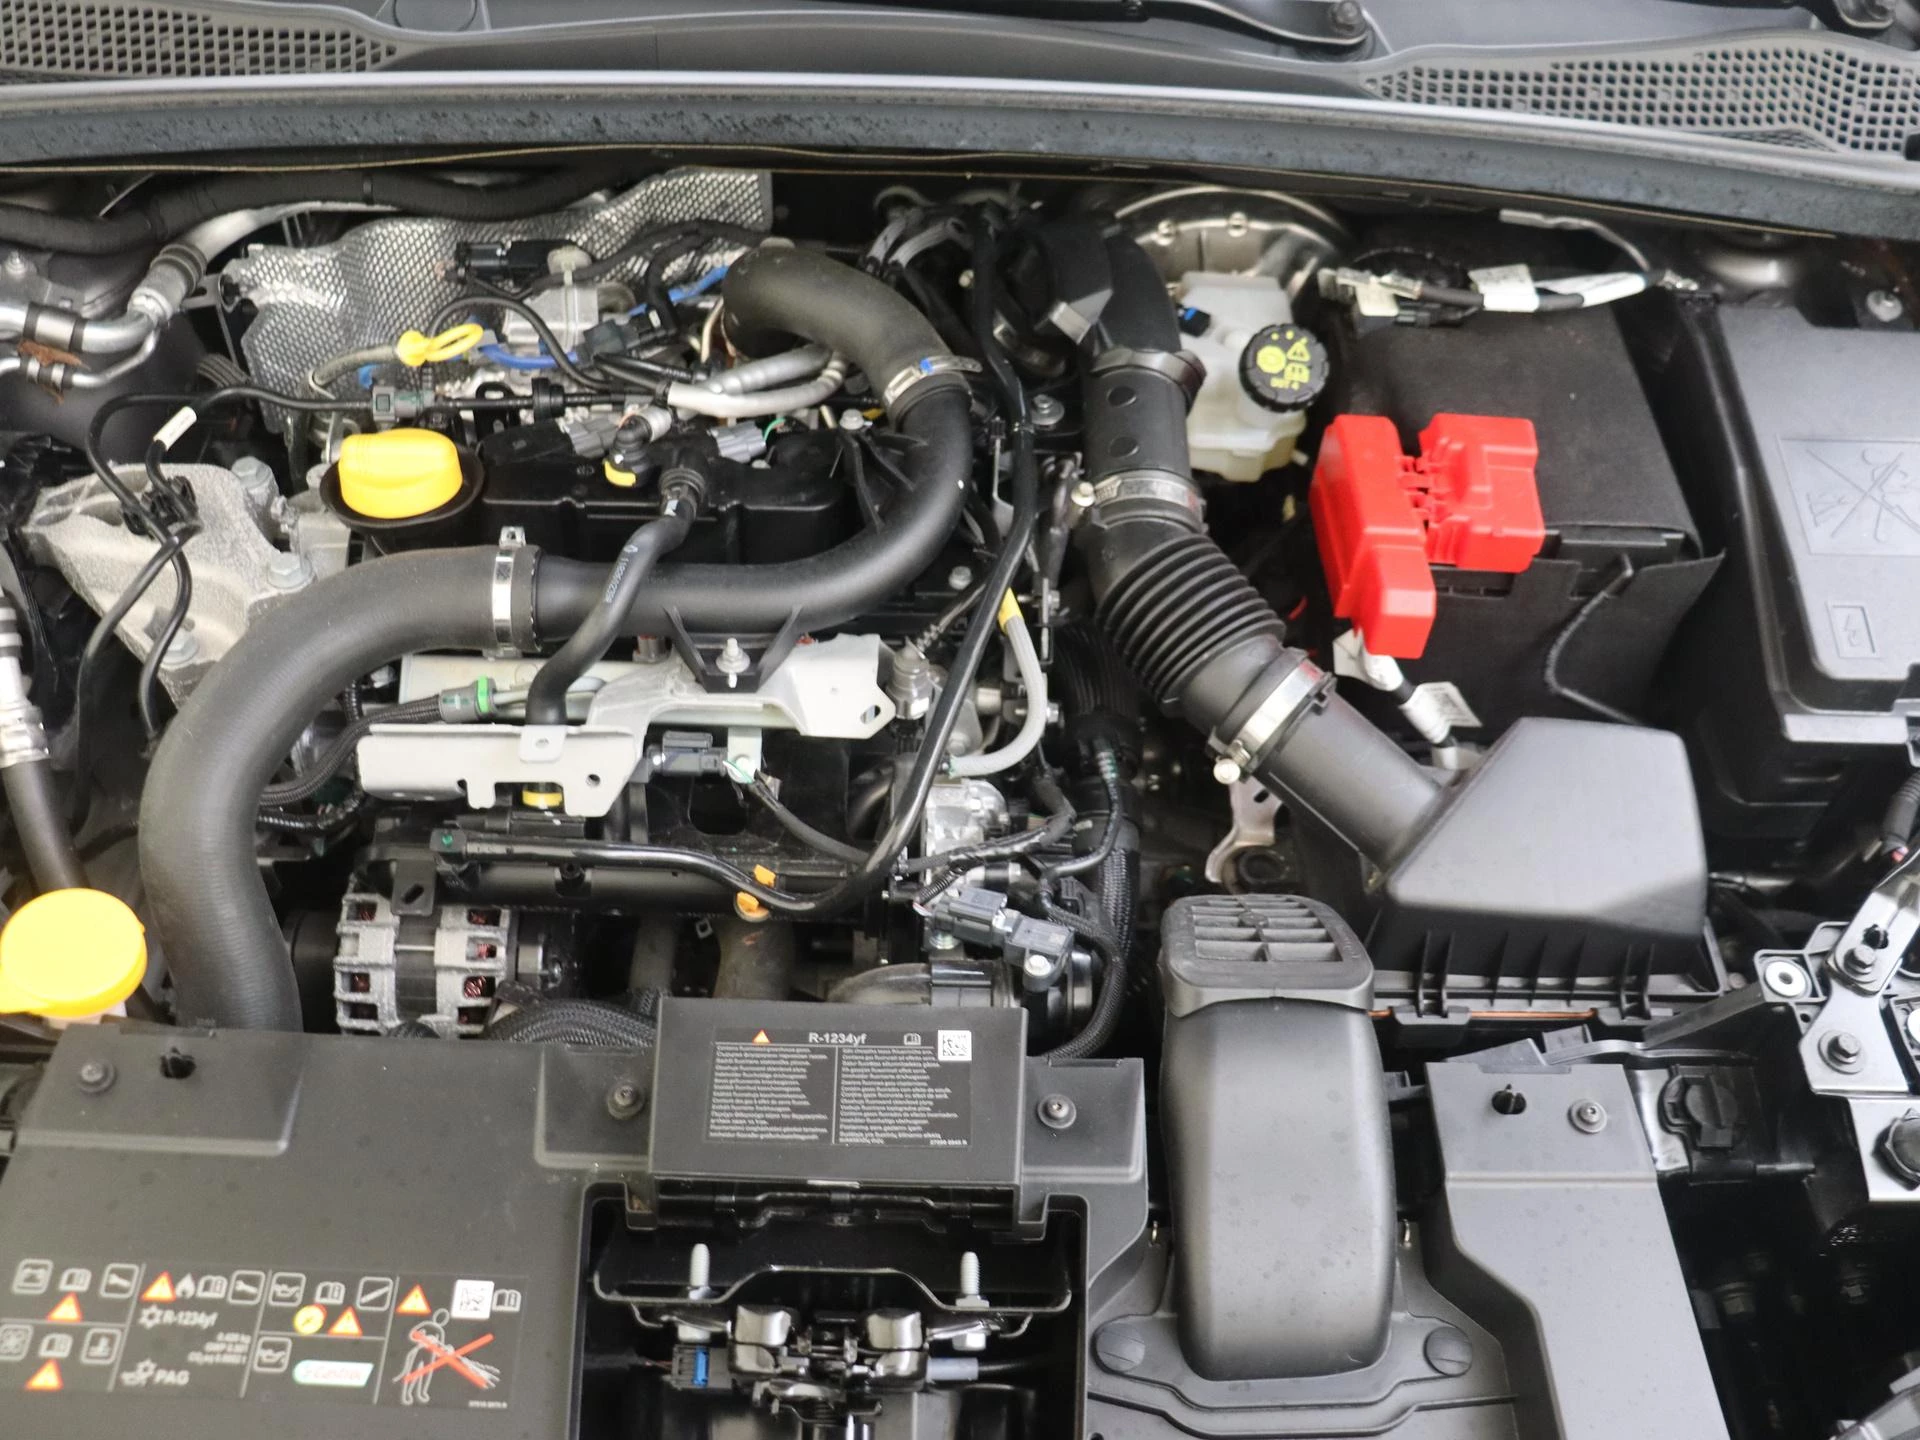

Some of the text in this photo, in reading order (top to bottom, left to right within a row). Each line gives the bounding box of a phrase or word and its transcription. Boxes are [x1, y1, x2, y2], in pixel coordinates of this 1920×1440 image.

[808, 1032, 867, 1047] R-1234yf
[162, 1309, 219, 1329] R-1234yf
[154, 1369, 191, 1386] PAG
